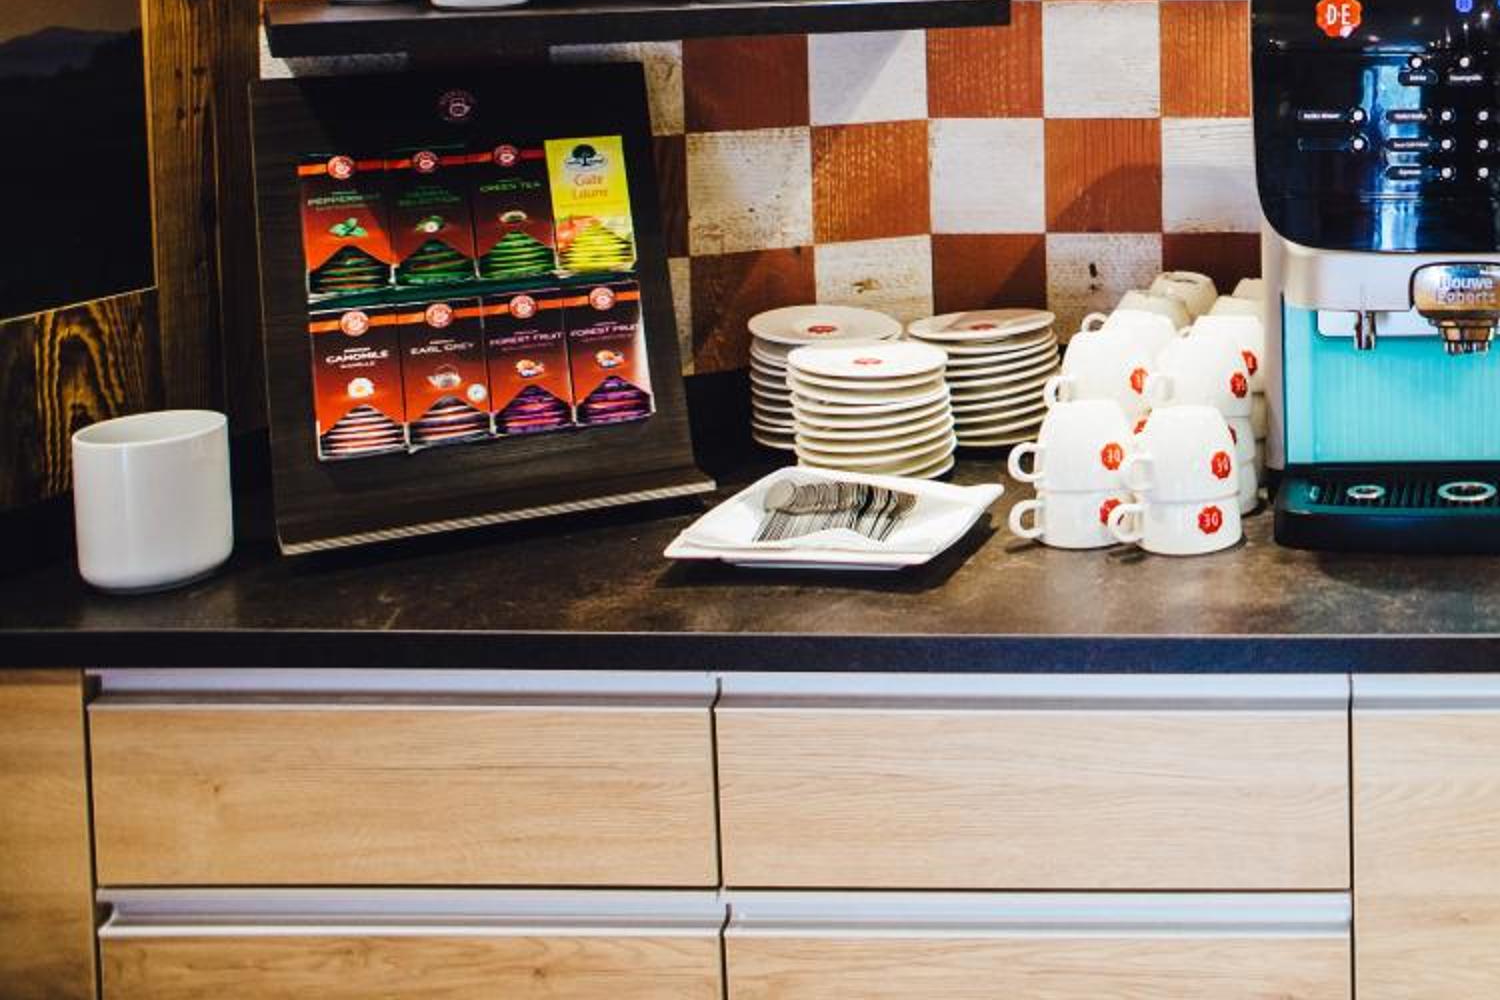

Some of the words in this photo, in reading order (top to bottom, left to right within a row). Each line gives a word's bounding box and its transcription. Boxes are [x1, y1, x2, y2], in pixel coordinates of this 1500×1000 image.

[570, 326, 611, 338] FOREST
[411, 346, 442, 356] EARL
[444, 342, 474, 352] GREY
[325, 349, 389, 364] CAMOMILE
